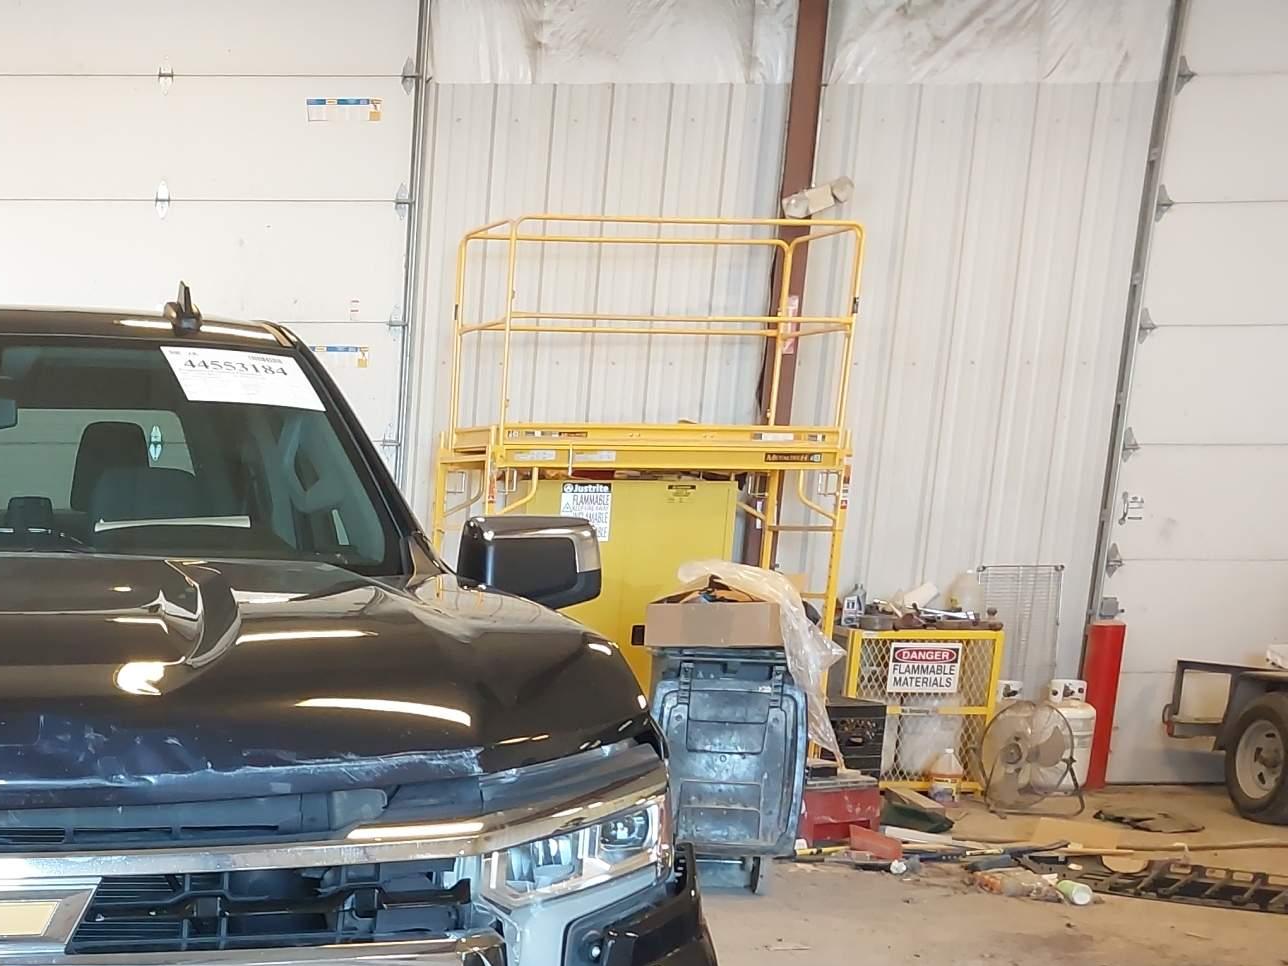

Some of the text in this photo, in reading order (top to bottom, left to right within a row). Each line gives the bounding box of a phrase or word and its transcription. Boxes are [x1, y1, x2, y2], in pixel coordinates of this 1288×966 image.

[184, 359, 288, 376] 44553184
[573, 483, 609, 493] Justrite
[573, 494, 610, 506] FLAMMABLE
[901, 650, 950, 660] DANGER
[892, 664, 956, 676] FLAMMABLE
[892, 677, 953, 688] MATERIALS
